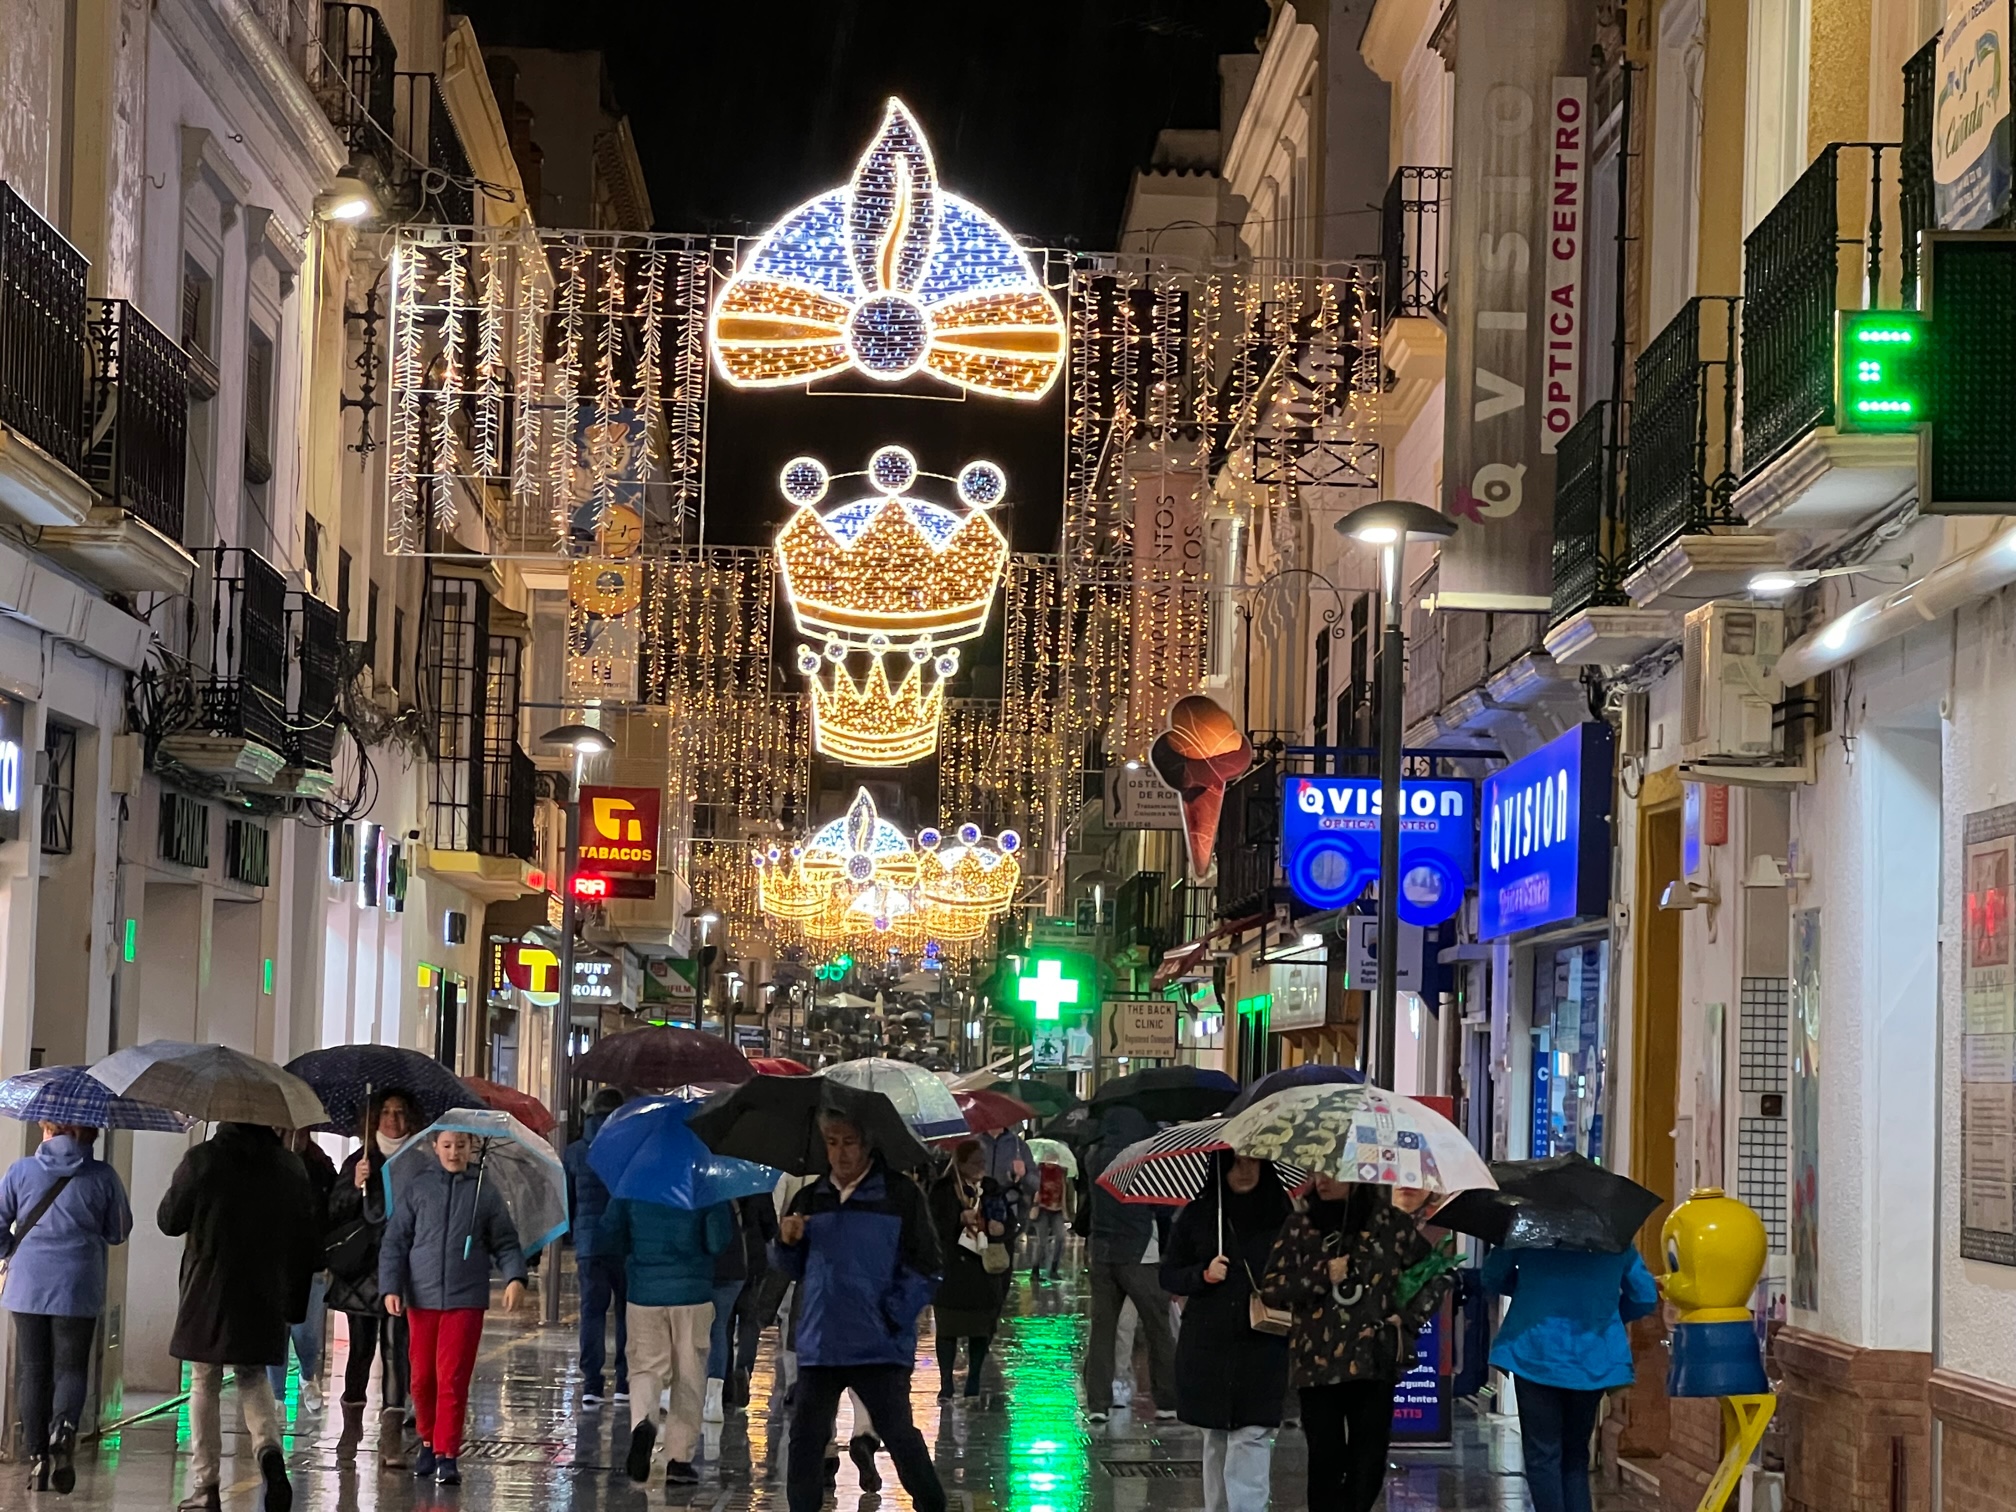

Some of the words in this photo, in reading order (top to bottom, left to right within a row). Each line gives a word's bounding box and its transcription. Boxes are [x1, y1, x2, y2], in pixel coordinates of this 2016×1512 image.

[1551, 97, 1581, 261] CENTRO
[1543, 285, 1576, 434] ÓPTICA
[1139, 791, 1153, 799] DE
[578, 846, 652, 861] TABACOS
[575, 962, 612, 975] PUNT
[572, 984, 612, 997] ROMA
[1128, 1005, 1145, 1015] THE
[1147, 1005, 1172, 1015] BACK
[1135, 1019, 1164, 1029] CLINIC
[1393, 1395, 1405, 1403] de
[1407, 1395, 1438, 1403] lentes
[1393, 1409, 1422, 1419] ATIS
